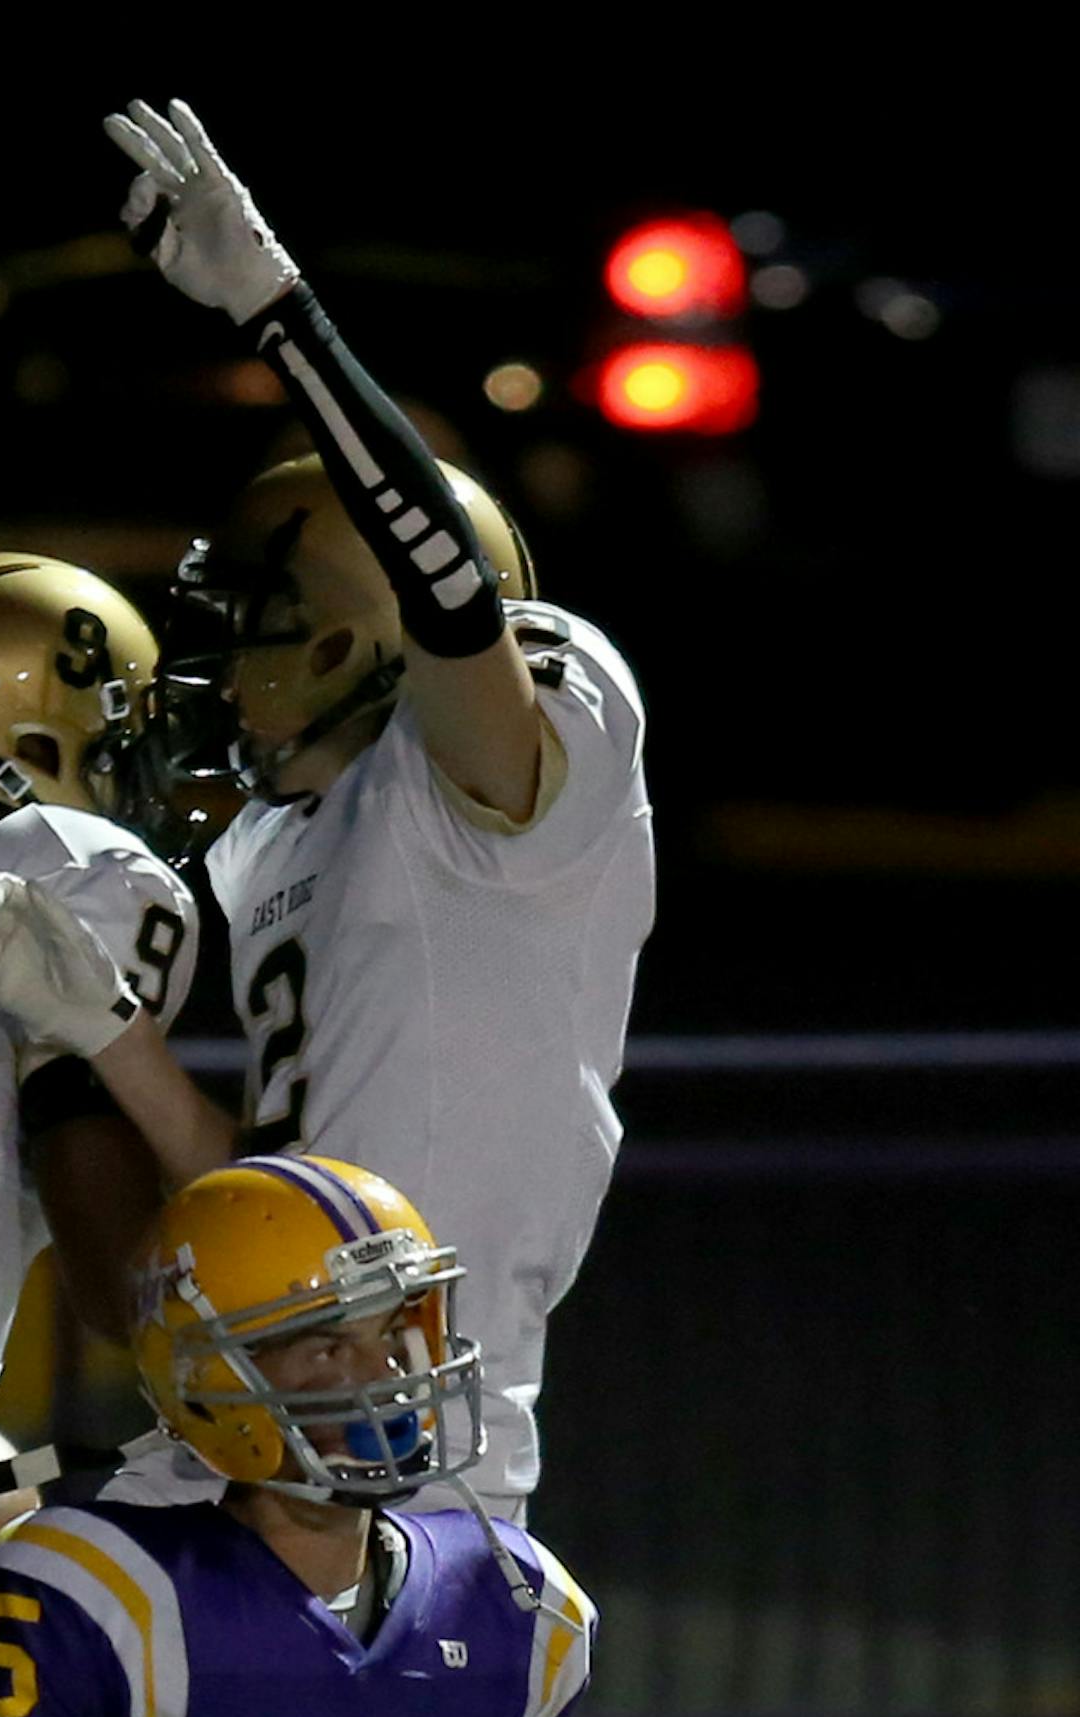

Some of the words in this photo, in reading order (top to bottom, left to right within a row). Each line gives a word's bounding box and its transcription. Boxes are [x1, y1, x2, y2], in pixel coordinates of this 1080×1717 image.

[56, 606, 112, 688] 9
[125, 902, 185, 1017] 9
[249, 890, 285, 936] EAST
[236, 933, 309, 1157] 2
